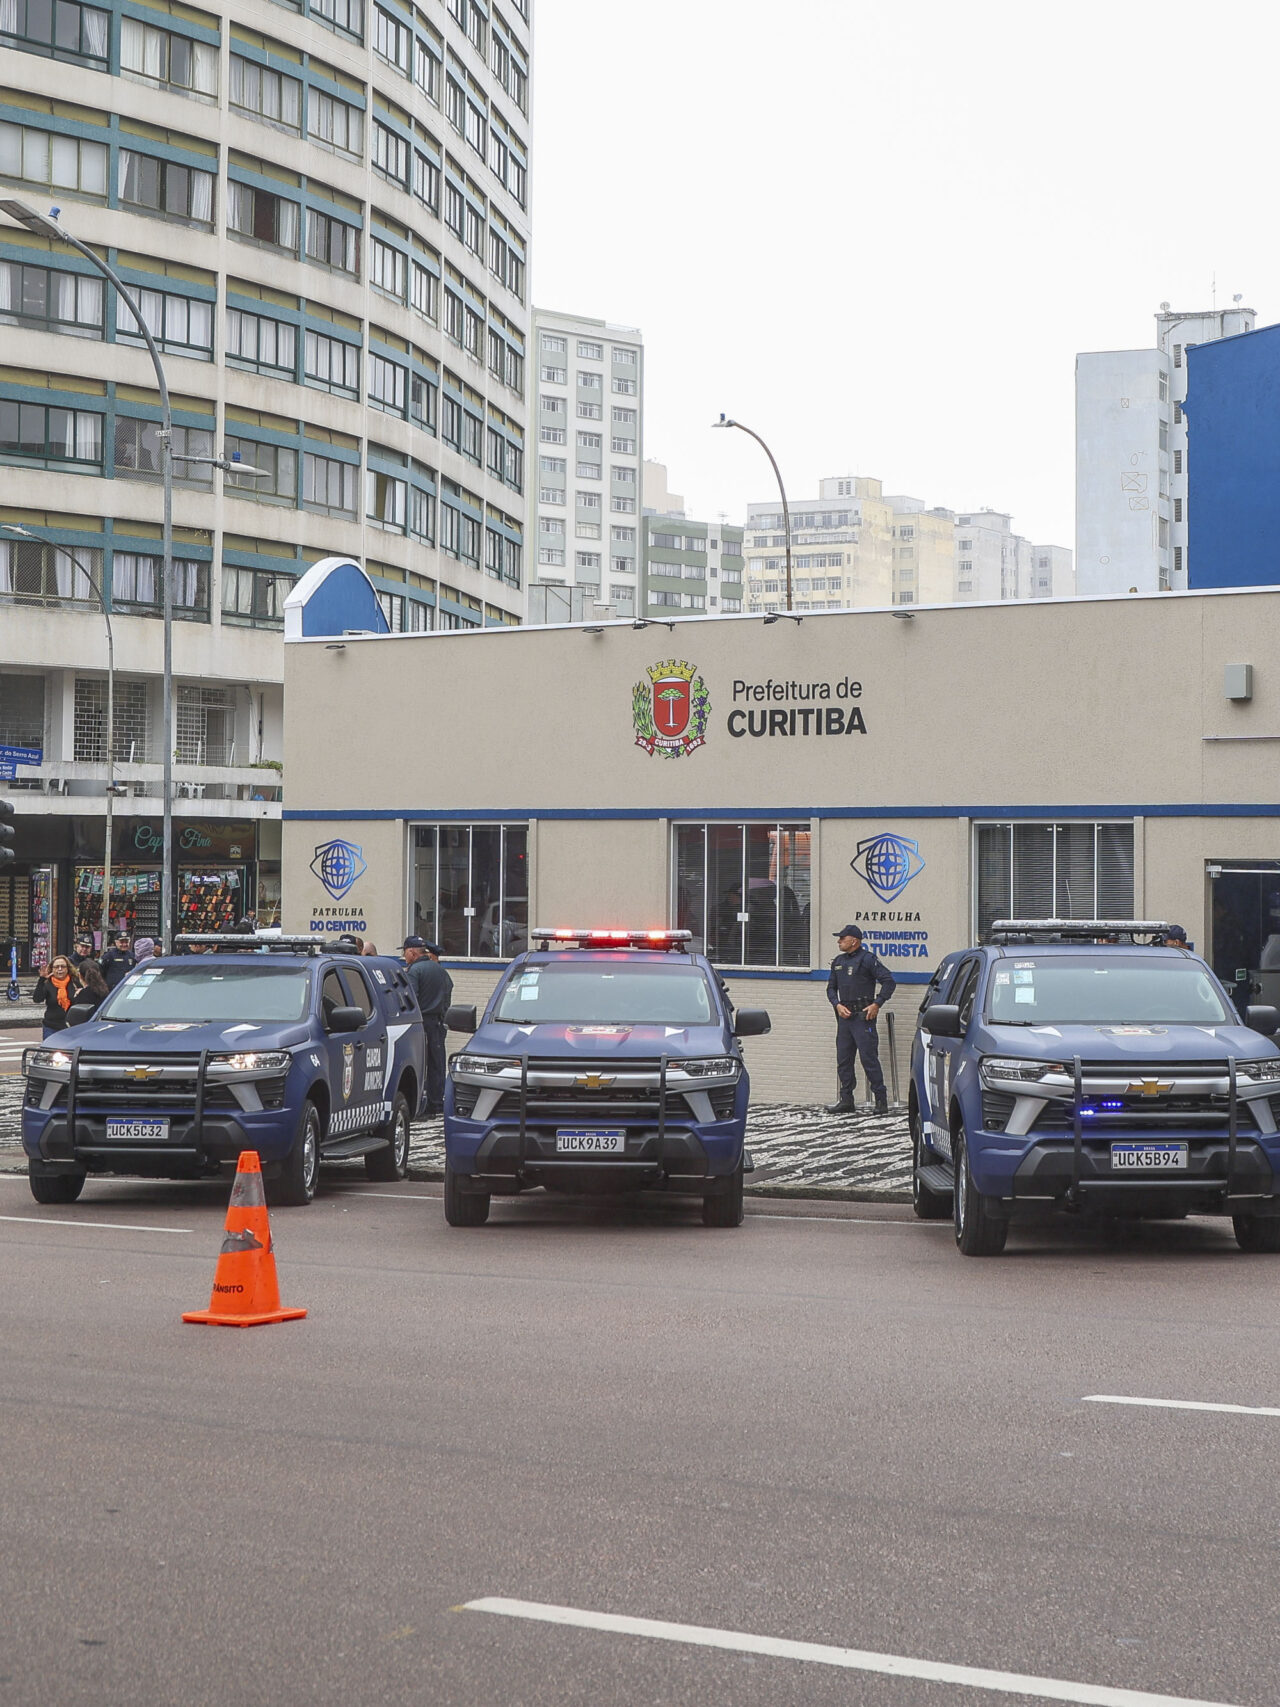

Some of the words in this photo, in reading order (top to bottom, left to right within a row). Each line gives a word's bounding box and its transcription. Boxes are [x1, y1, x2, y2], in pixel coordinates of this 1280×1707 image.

[732, 679, 831, 702] Prefeitura
[836, 676, 863, 699] de
[727, 706, 868, 738] CURITIBA
[654, 738, 684, 747] CURITIBA
[134, 825, 165, 853] Cap
[312, 907, 364, 917] PATRULHA
[855, 911, 921, 922] PATRULHA
[310, 920, 325, 932] DO
[325, 920, 367, 932] CENTRO
[862, 930, 929, 941] ATENDIMENTO
[871, 943, 929, 958] TURISTA
[111, 1125, 162, 1137] UCK5C32
[562, 1137, 618, 1150] UCK9A39
[1118, 1151, 1179, 1166] UCK5B94
